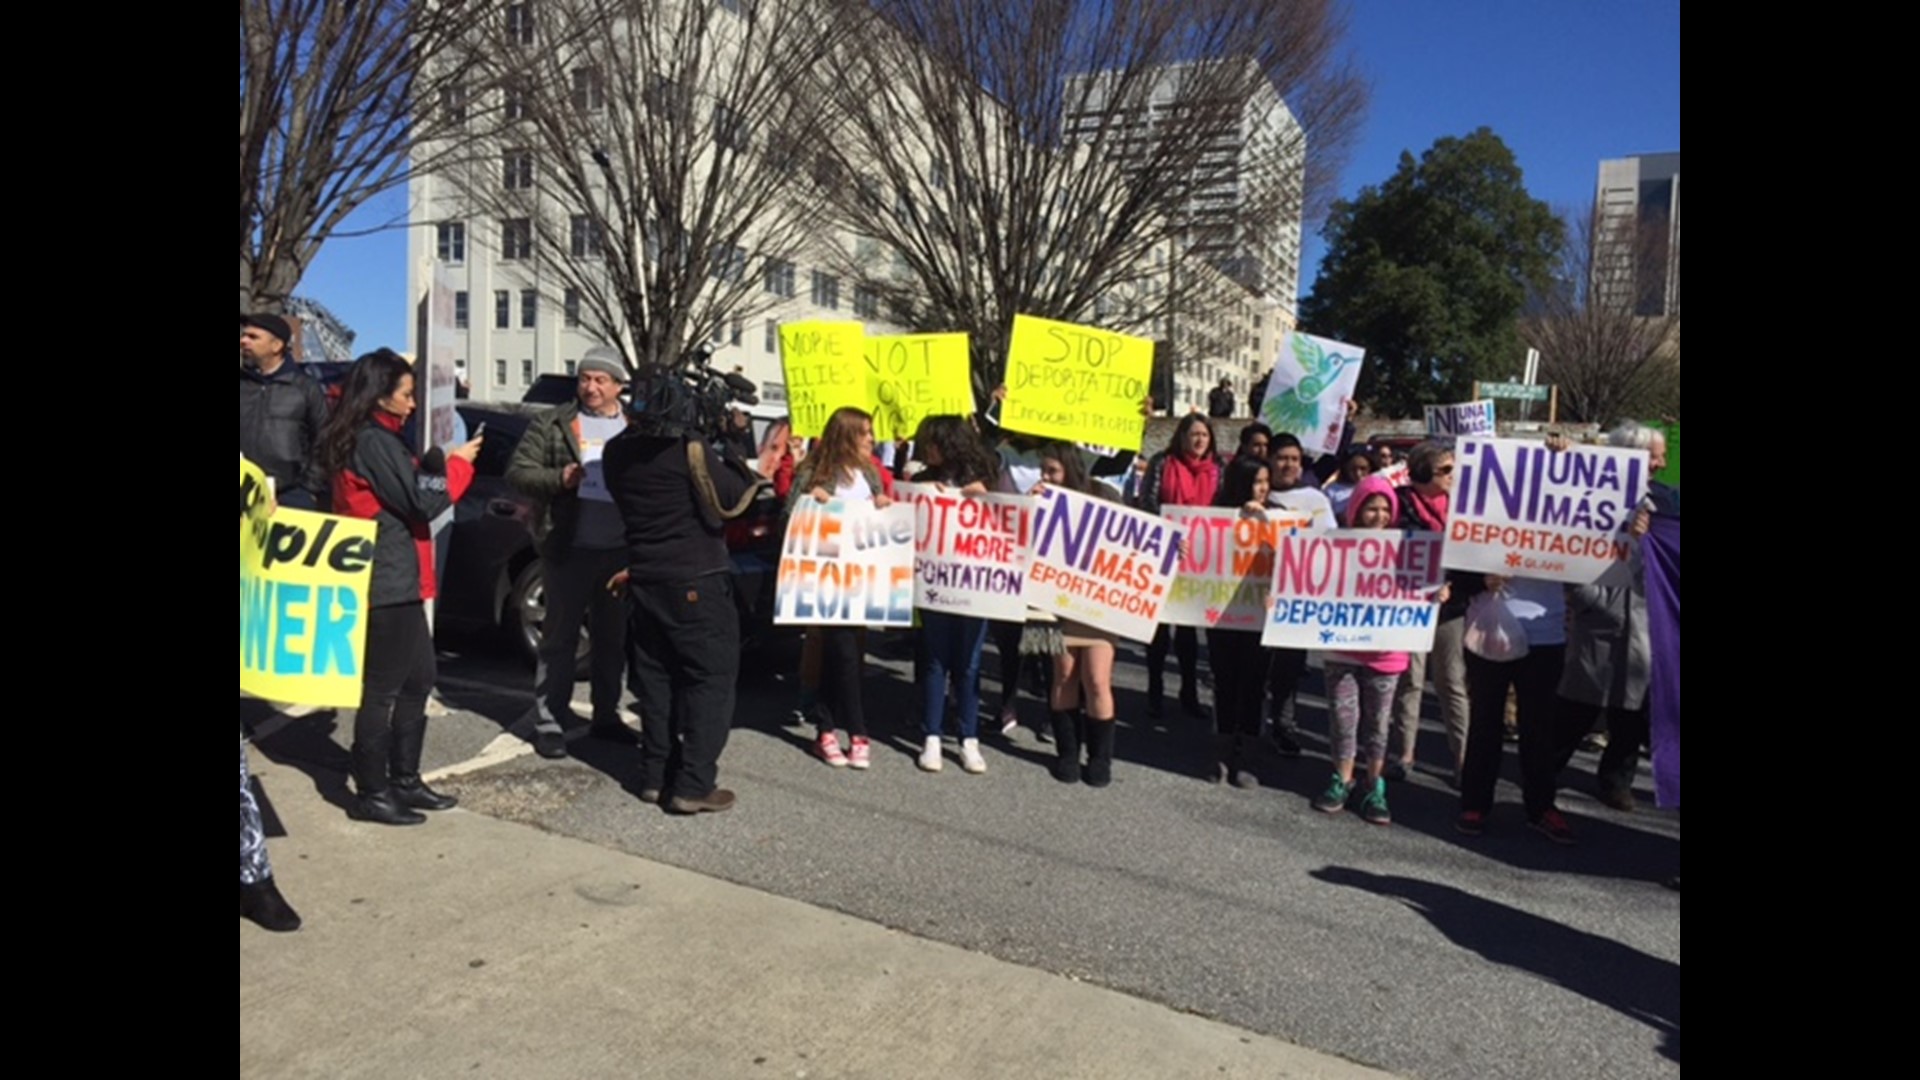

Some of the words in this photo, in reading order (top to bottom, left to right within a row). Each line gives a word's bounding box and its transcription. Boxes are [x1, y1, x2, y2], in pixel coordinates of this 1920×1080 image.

[1043, 326, 1124, 369] STOP
[877, 379, 931, 406] ONE
[1014, 361, 1149, 400] DEPORTATION
[1456, 442, 1545, 522] ¡NI
[1548, 449, 1620, 491] UNA
[786, 497, 846, 558] WE
[853, 511, 912, 551] the
[958, 497, 1017, 535] ONE
[1104, 509, 1164, 558] UNA
[1451, 520, 1629, 560] DEPORTACIÓN
[1277, 535, 1357, 597] NOT
[1358, 537, 1426, 571] ONE
[773, 558, 913, 621] PEOPLE
[1273, 598, 1432, 627] DEPORTATION
